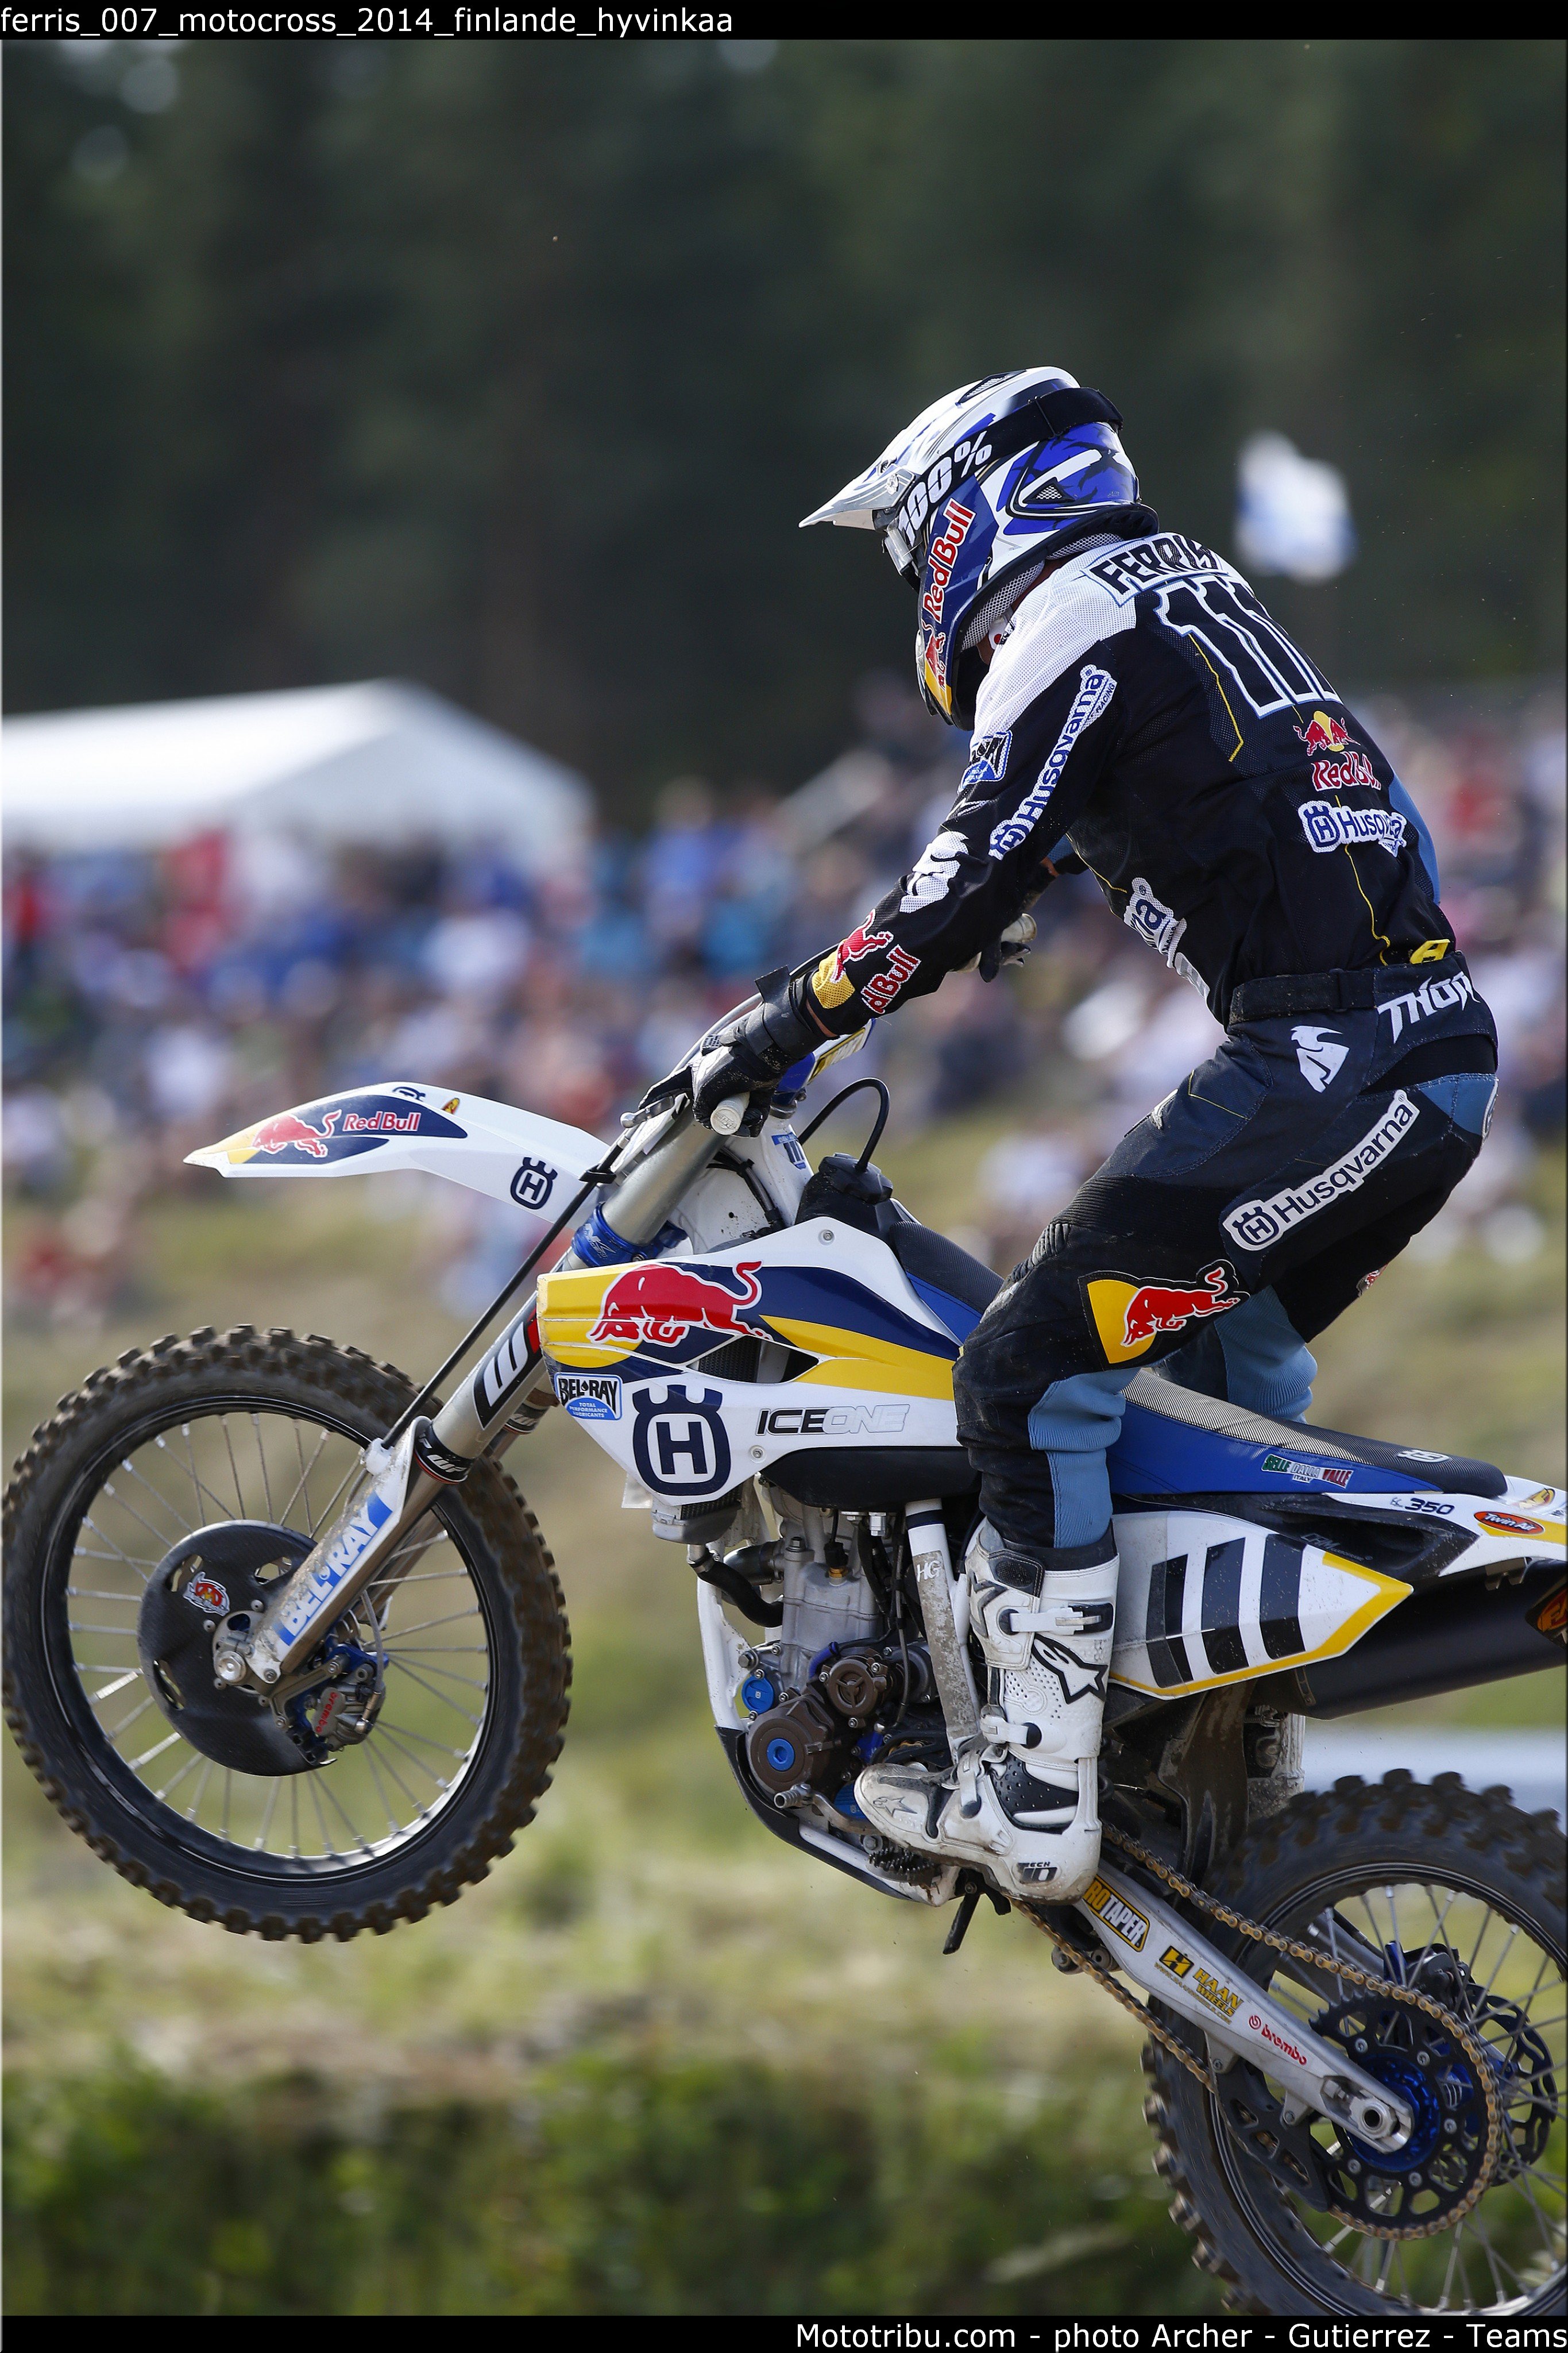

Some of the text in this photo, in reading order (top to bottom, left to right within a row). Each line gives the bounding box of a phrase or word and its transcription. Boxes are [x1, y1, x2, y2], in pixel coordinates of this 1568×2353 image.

[898, 431, 992, 547] 100%
[1090, 535, 1218, 595] FERRIS
[1377, 971, 1481, 1044] THOR
[343, 1111, 421, 1131] Red Bull
[1271, 1103, 1413, 1223] Husqvarna
[1294, 1474, 1312, 1482] ITALY
[1405, 1498, 1455, 1515] 350
[1484, 1513, 1516, 1526] Twin
[1193, 1968, 1244, 2011] HAAN
[1196, 1983, 1235, 2017] WHEELS
[1261, 2024, 1307, 2065] brembo
